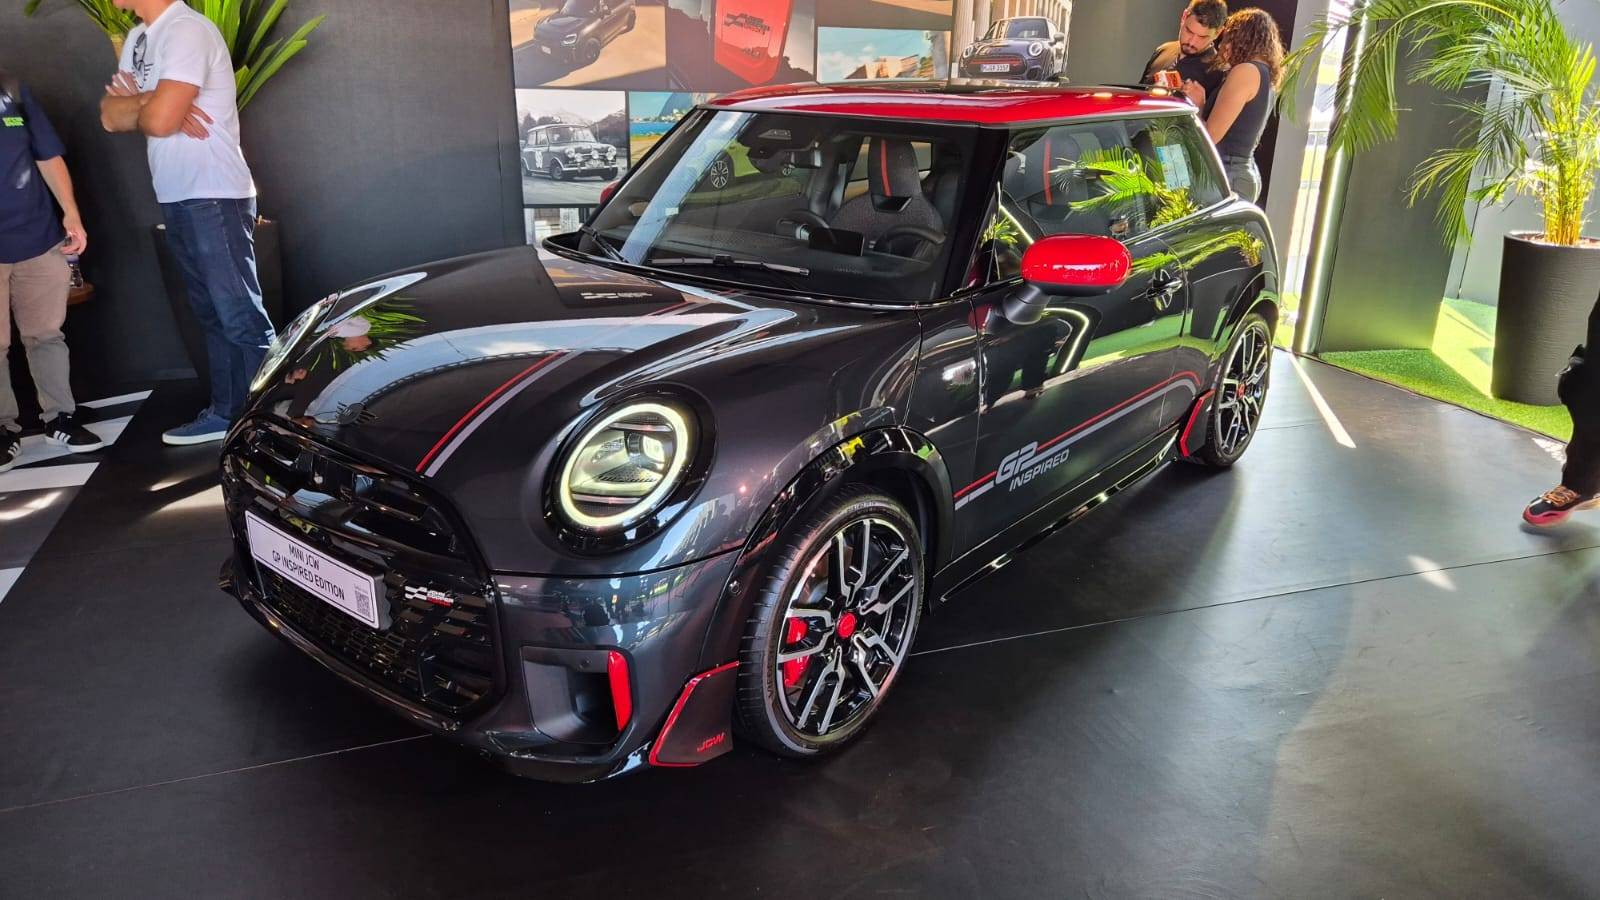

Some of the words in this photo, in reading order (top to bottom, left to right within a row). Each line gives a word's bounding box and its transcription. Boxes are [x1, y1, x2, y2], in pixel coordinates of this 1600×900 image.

[995, 441, 1038, 484] GP
[1009, 448, 1070, 492] INSPIRED
[272, 550, 281, 563] GP
[282, 554, 314, 583] INSPIRED
[314, 574, 345, 600] EDITION
[288, 544, 305, 562] MINI
[306, 553, 320, 571] JCW
[697, 732, 726, 752] JCW
